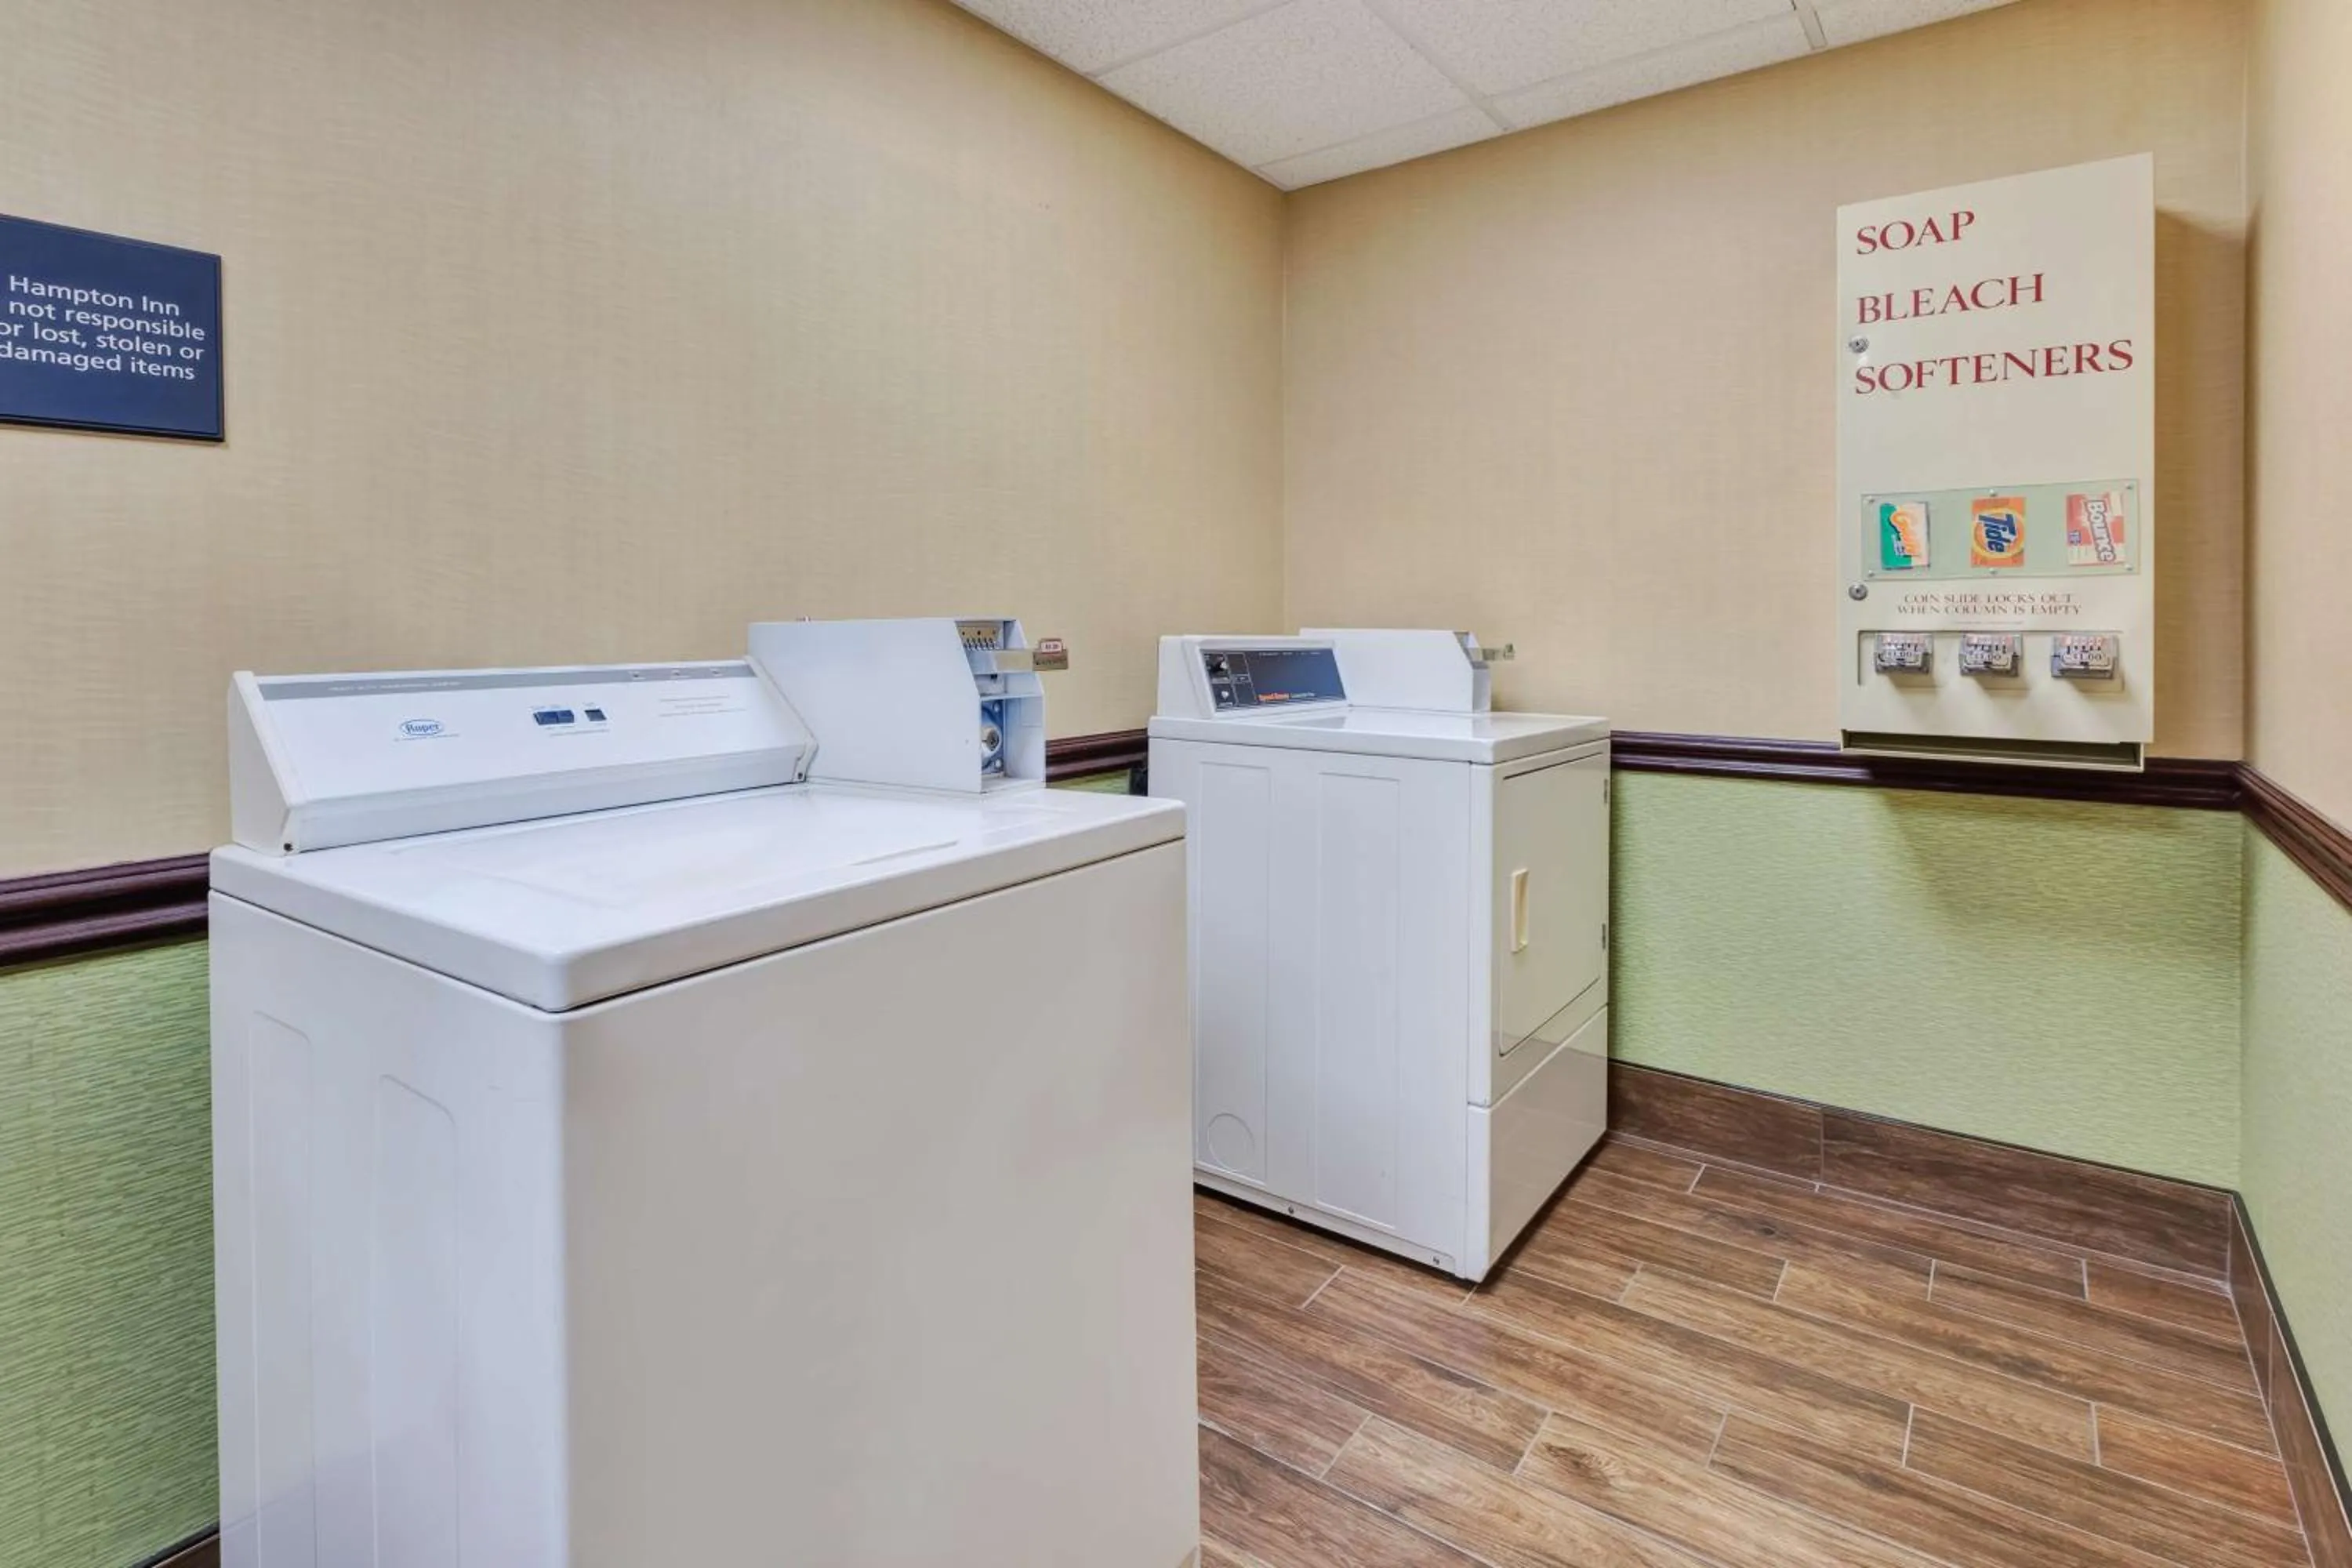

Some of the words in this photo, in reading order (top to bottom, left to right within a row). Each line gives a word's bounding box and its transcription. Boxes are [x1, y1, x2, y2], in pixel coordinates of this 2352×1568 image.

[1856, 210, 1975, 255] SOAP
[9, 275, 133, 309] Hampton
[142, 296, 180, 316] Inn
[1857, 273, 2044, 325] BLEACH
[9, 300, 56, 320] not
[65, 308, 205, 341] responsible
[34, 321, 86, 348] lost,
[96, 334, 171, 357] stolen
[180, 347, 205, 361] or
[0, 341, 121, 372] damaged
[130, 358, 195, 380] items
[1855, 339, 2133, 394] SOFTENERS
[1978, 513, 2017, 554] Tide
[1897, 604, 1940, 615] WHEN
[1944, 604, 2008, 615] COLUMN
[2013, 604, 2026, 615] IS
[2031, 604, 2082, 615] EMPTY
[1904, 593, 1940, 604] COIN
[1944, 593, 1979, 604] SLIDE
[1987, 593, 2036, 603] LOCKS
[2040, 593, 2072, 603] OUT
